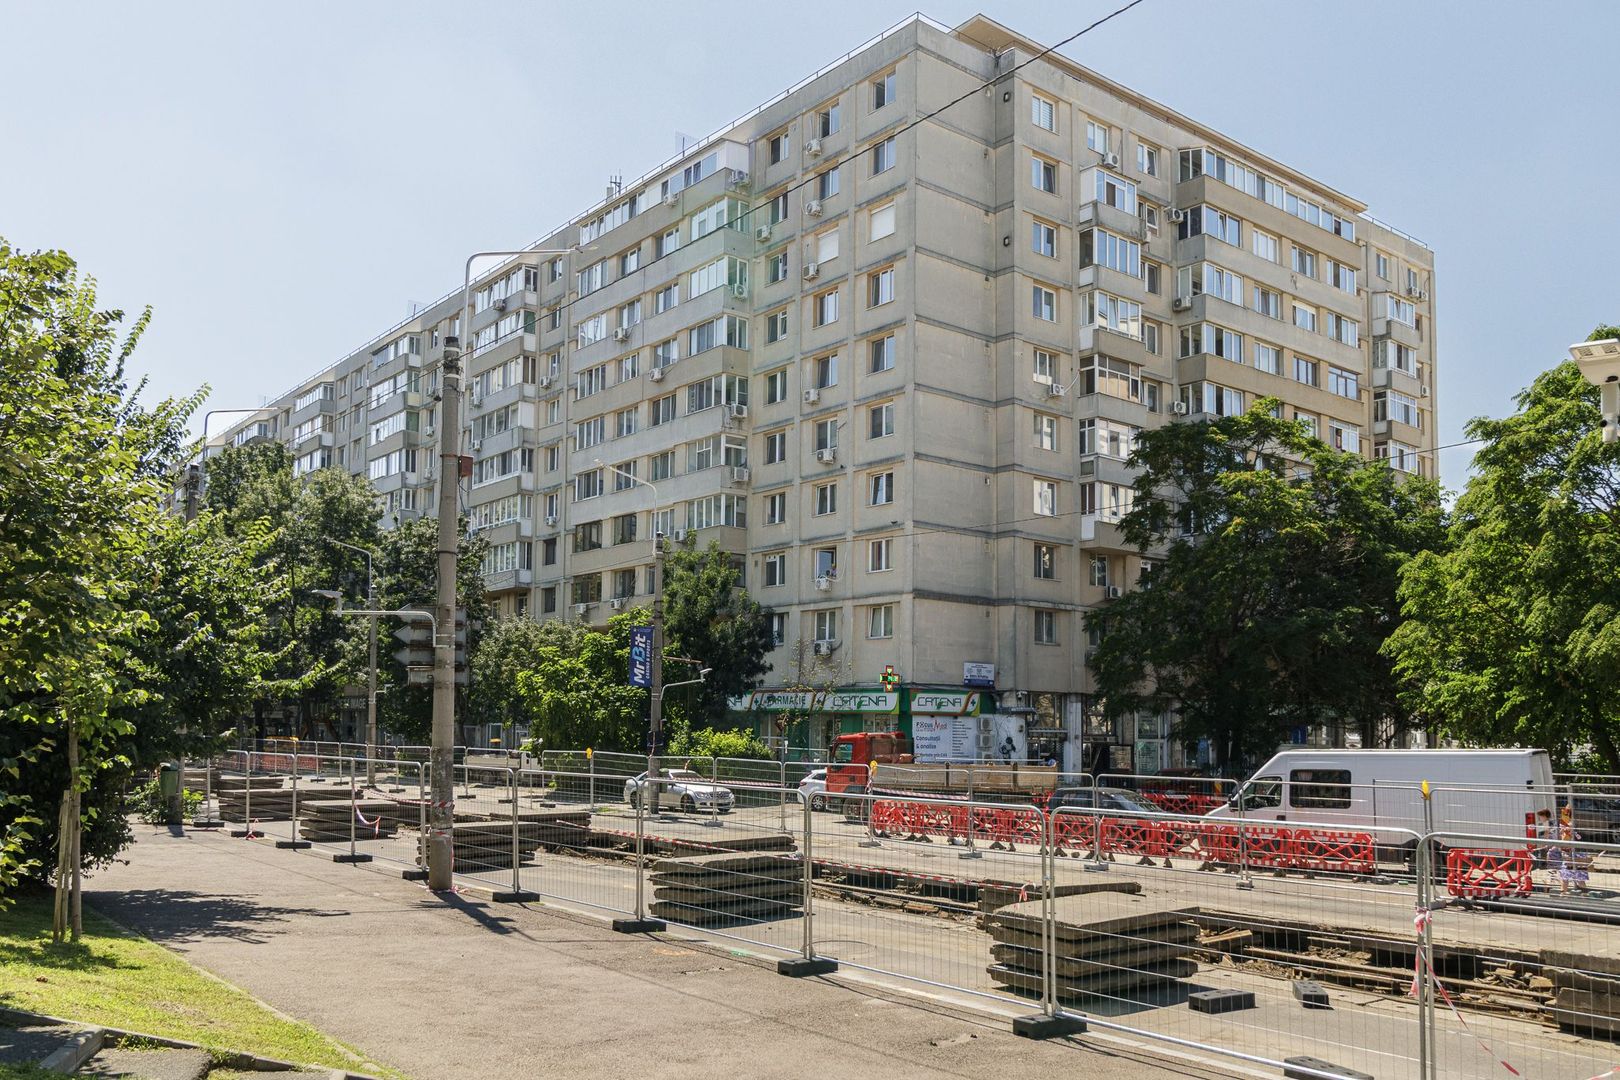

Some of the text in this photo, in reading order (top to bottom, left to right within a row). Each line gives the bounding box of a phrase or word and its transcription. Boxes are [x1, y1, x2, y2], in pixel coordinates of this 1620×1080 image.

[632, 634, 646, 684] MrBit
[832, 695, 887, 707] CATENA
[917, 696, 962, 707] CATENA
